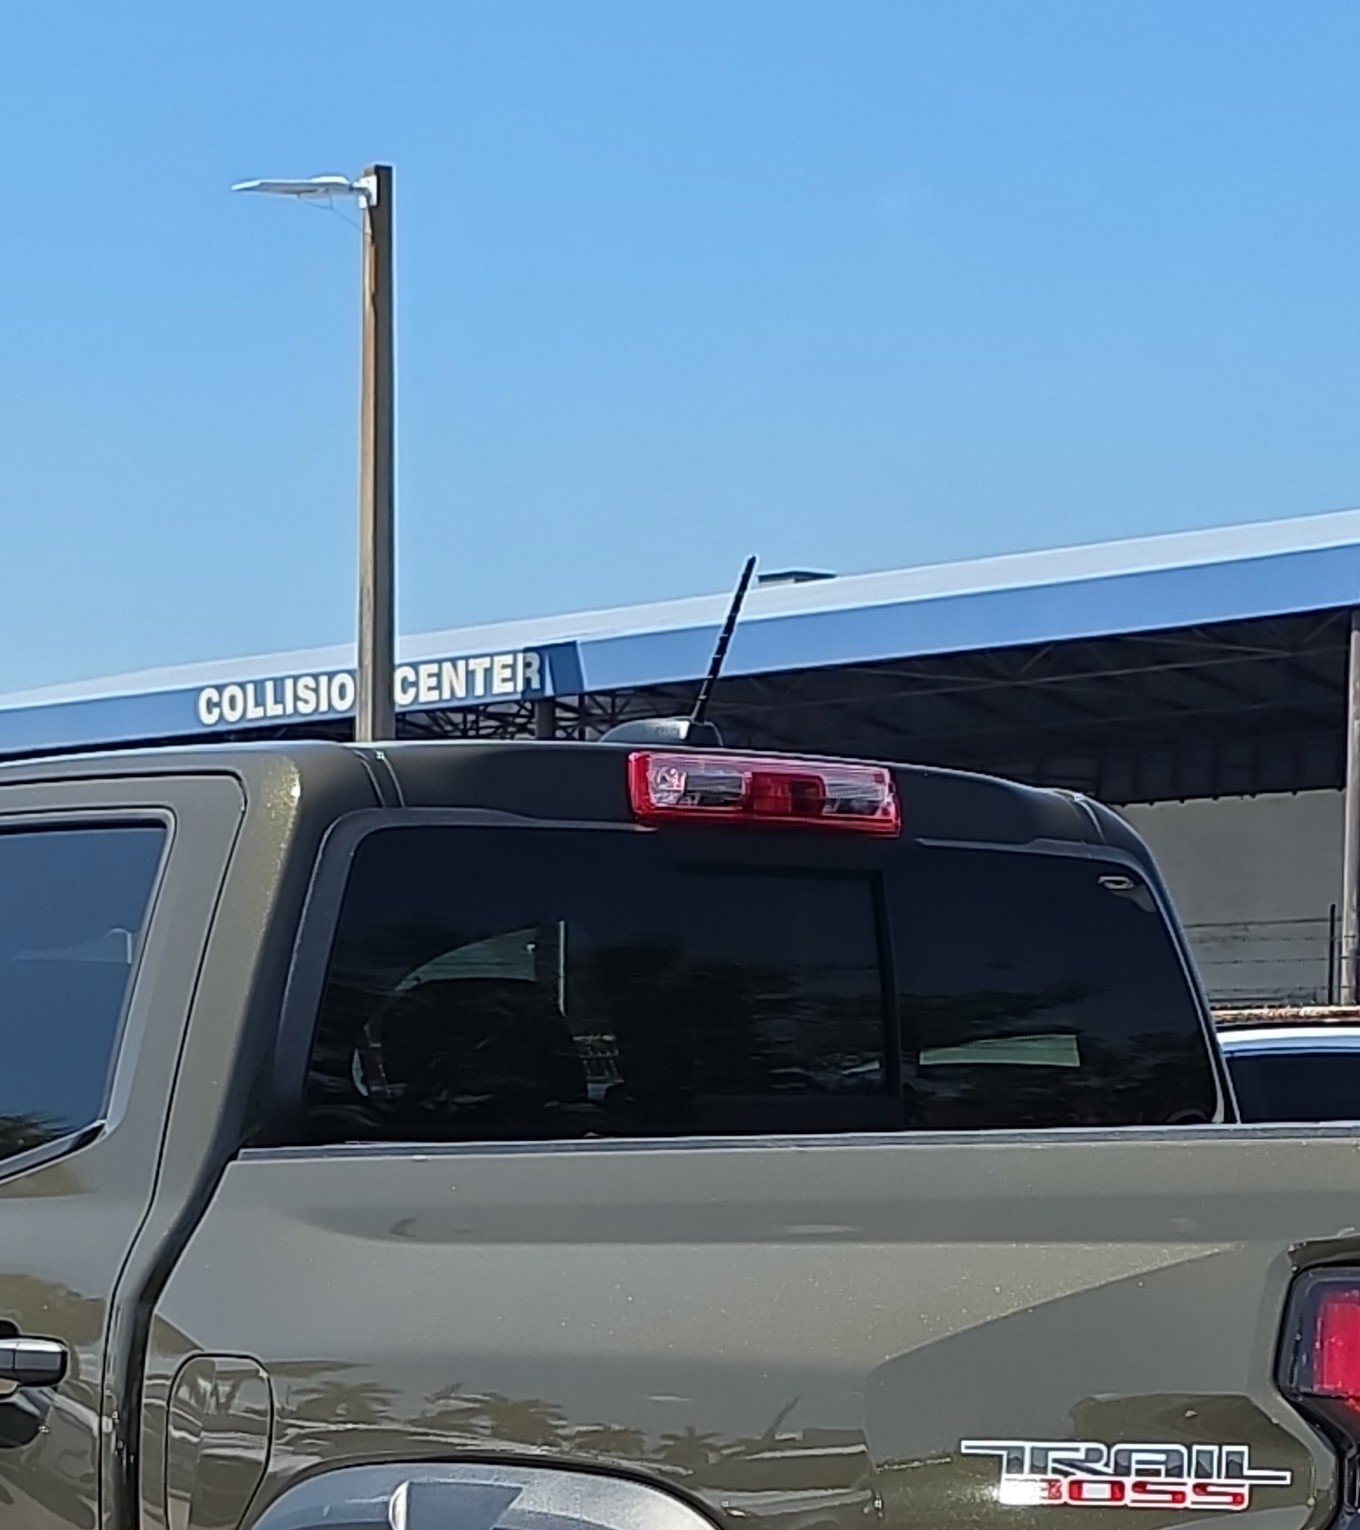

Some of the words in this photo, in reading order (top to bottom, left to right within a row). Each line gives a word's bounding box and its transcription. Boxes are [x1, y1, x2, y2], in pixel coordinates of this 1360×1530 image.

[197, 671, 357, 726] COLLISIO
[392, 651, 541, 706] CENTER
[960, 1440, 1292, 1485] TRAIL
[1000, 1474, 1251, 1510] BOSS
